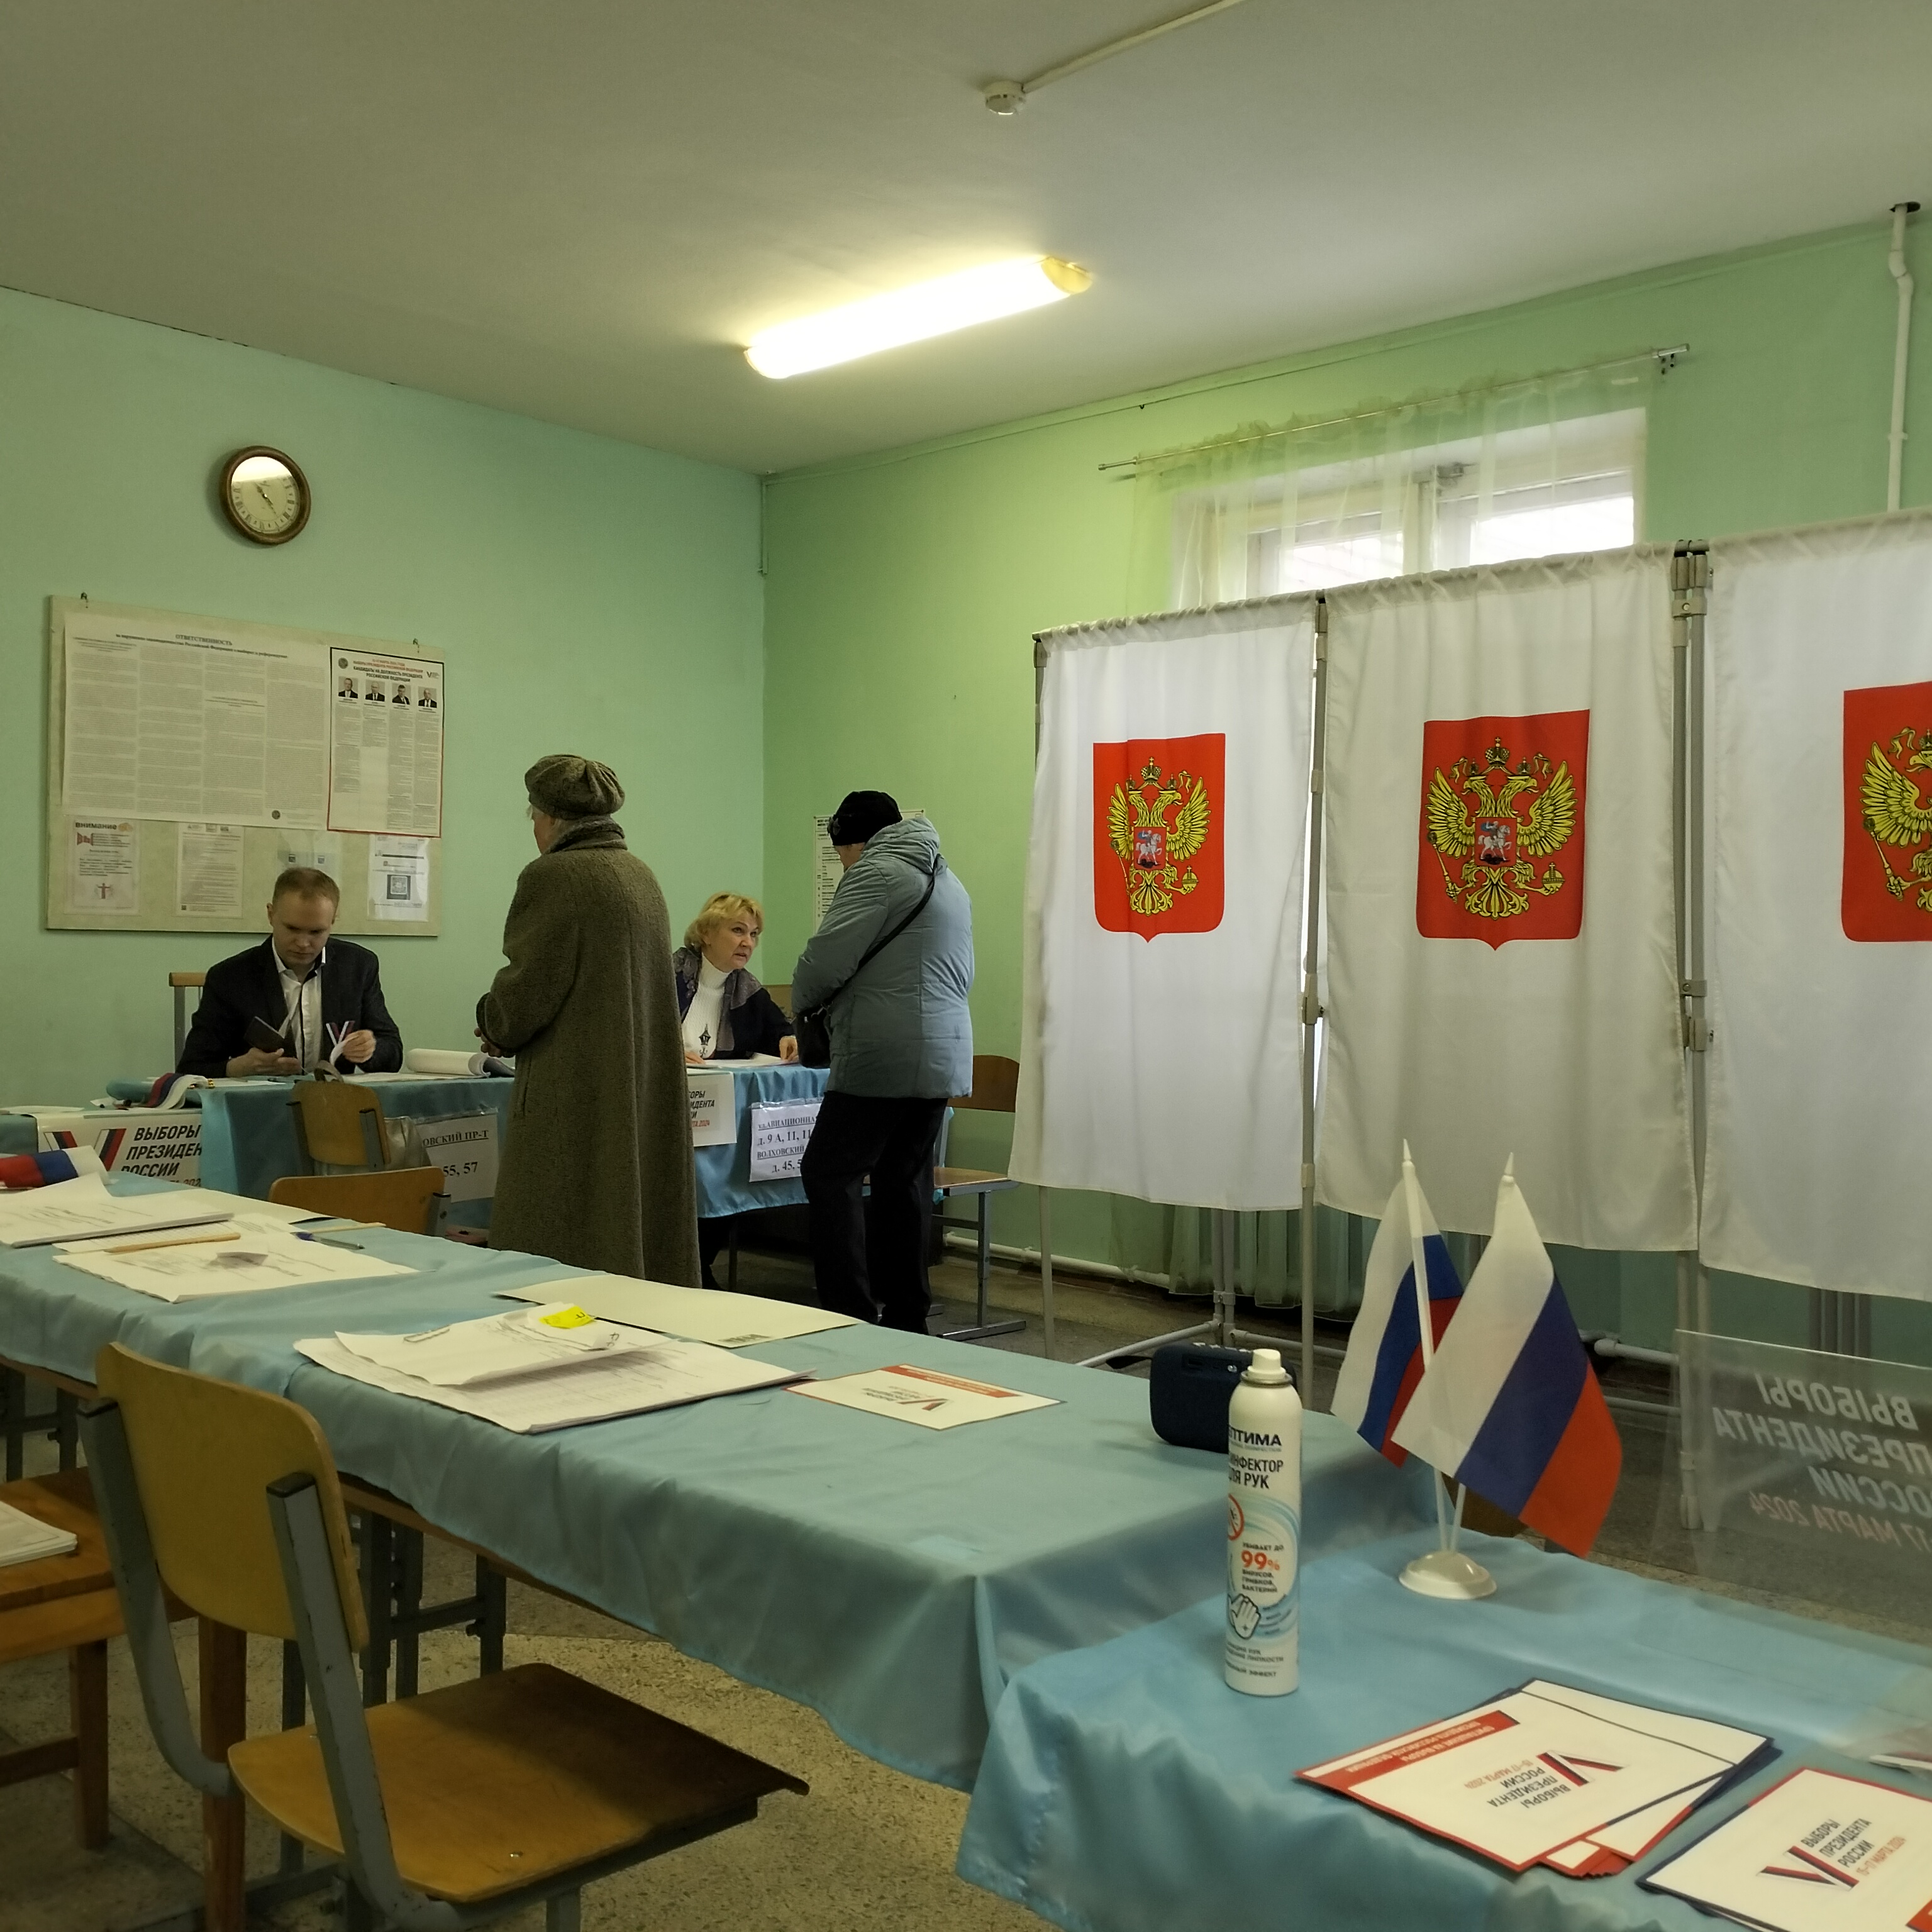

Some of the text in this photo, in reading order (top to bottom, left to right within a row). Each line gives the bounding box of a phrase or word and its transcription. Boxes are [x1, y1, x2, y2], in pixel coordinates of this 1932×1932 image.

[689, 1091, 706, 1099] ОРЫ
[134, 1125, 201, 1141] ВЫБОРЫ
[465, 1130, 489, 1140] ПР-Т
[757, 1145, 804, 1158] ВОЛХОВСКИЙ
[443, 1162, 478, 1177] 55, 57
[1244, 1472, 1269, 1489] РУК
[1241, 1550, 1280, 1570] 99%
[1484, 1768, 1512, 1782] МАРТА
[1500, 1767, 1546, 1789] РОССИИ
[1487, 1775, 1558, 1807] ПРЕЗИДЕНТА
[1520, 1784, 1571, 1808] ВЫБОРЫ
[1801, 1819, 1841, 1848] ВЫБОРЫ
[1819, 1818, 1872, 1858] ПРЕЗИДЕНТА
[1837, 1840, 1875, 1868] РОССИИ
[1872, 1846, 1894, 1865] МАРТА
